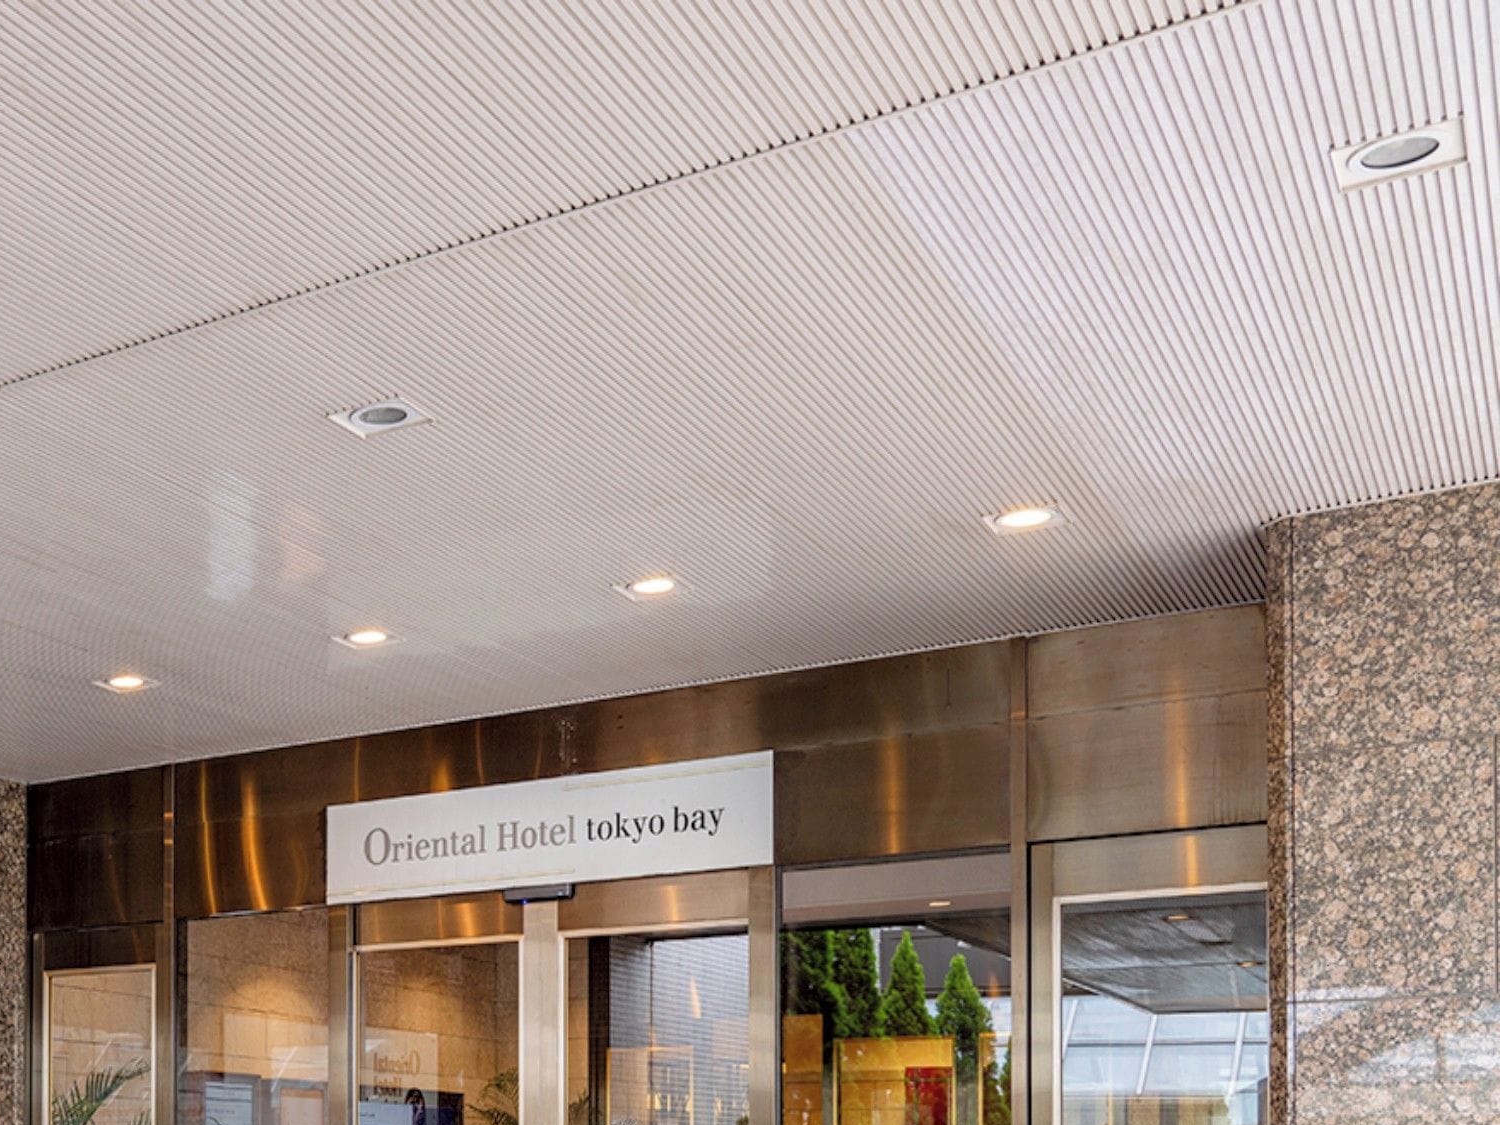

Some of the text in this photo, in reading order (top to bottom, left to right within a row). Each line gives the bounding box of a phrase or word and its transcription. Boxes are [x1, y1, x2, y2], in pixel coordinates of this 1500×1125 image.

[364, 806, 725, 866] Oriental Hotel tokyo bay
